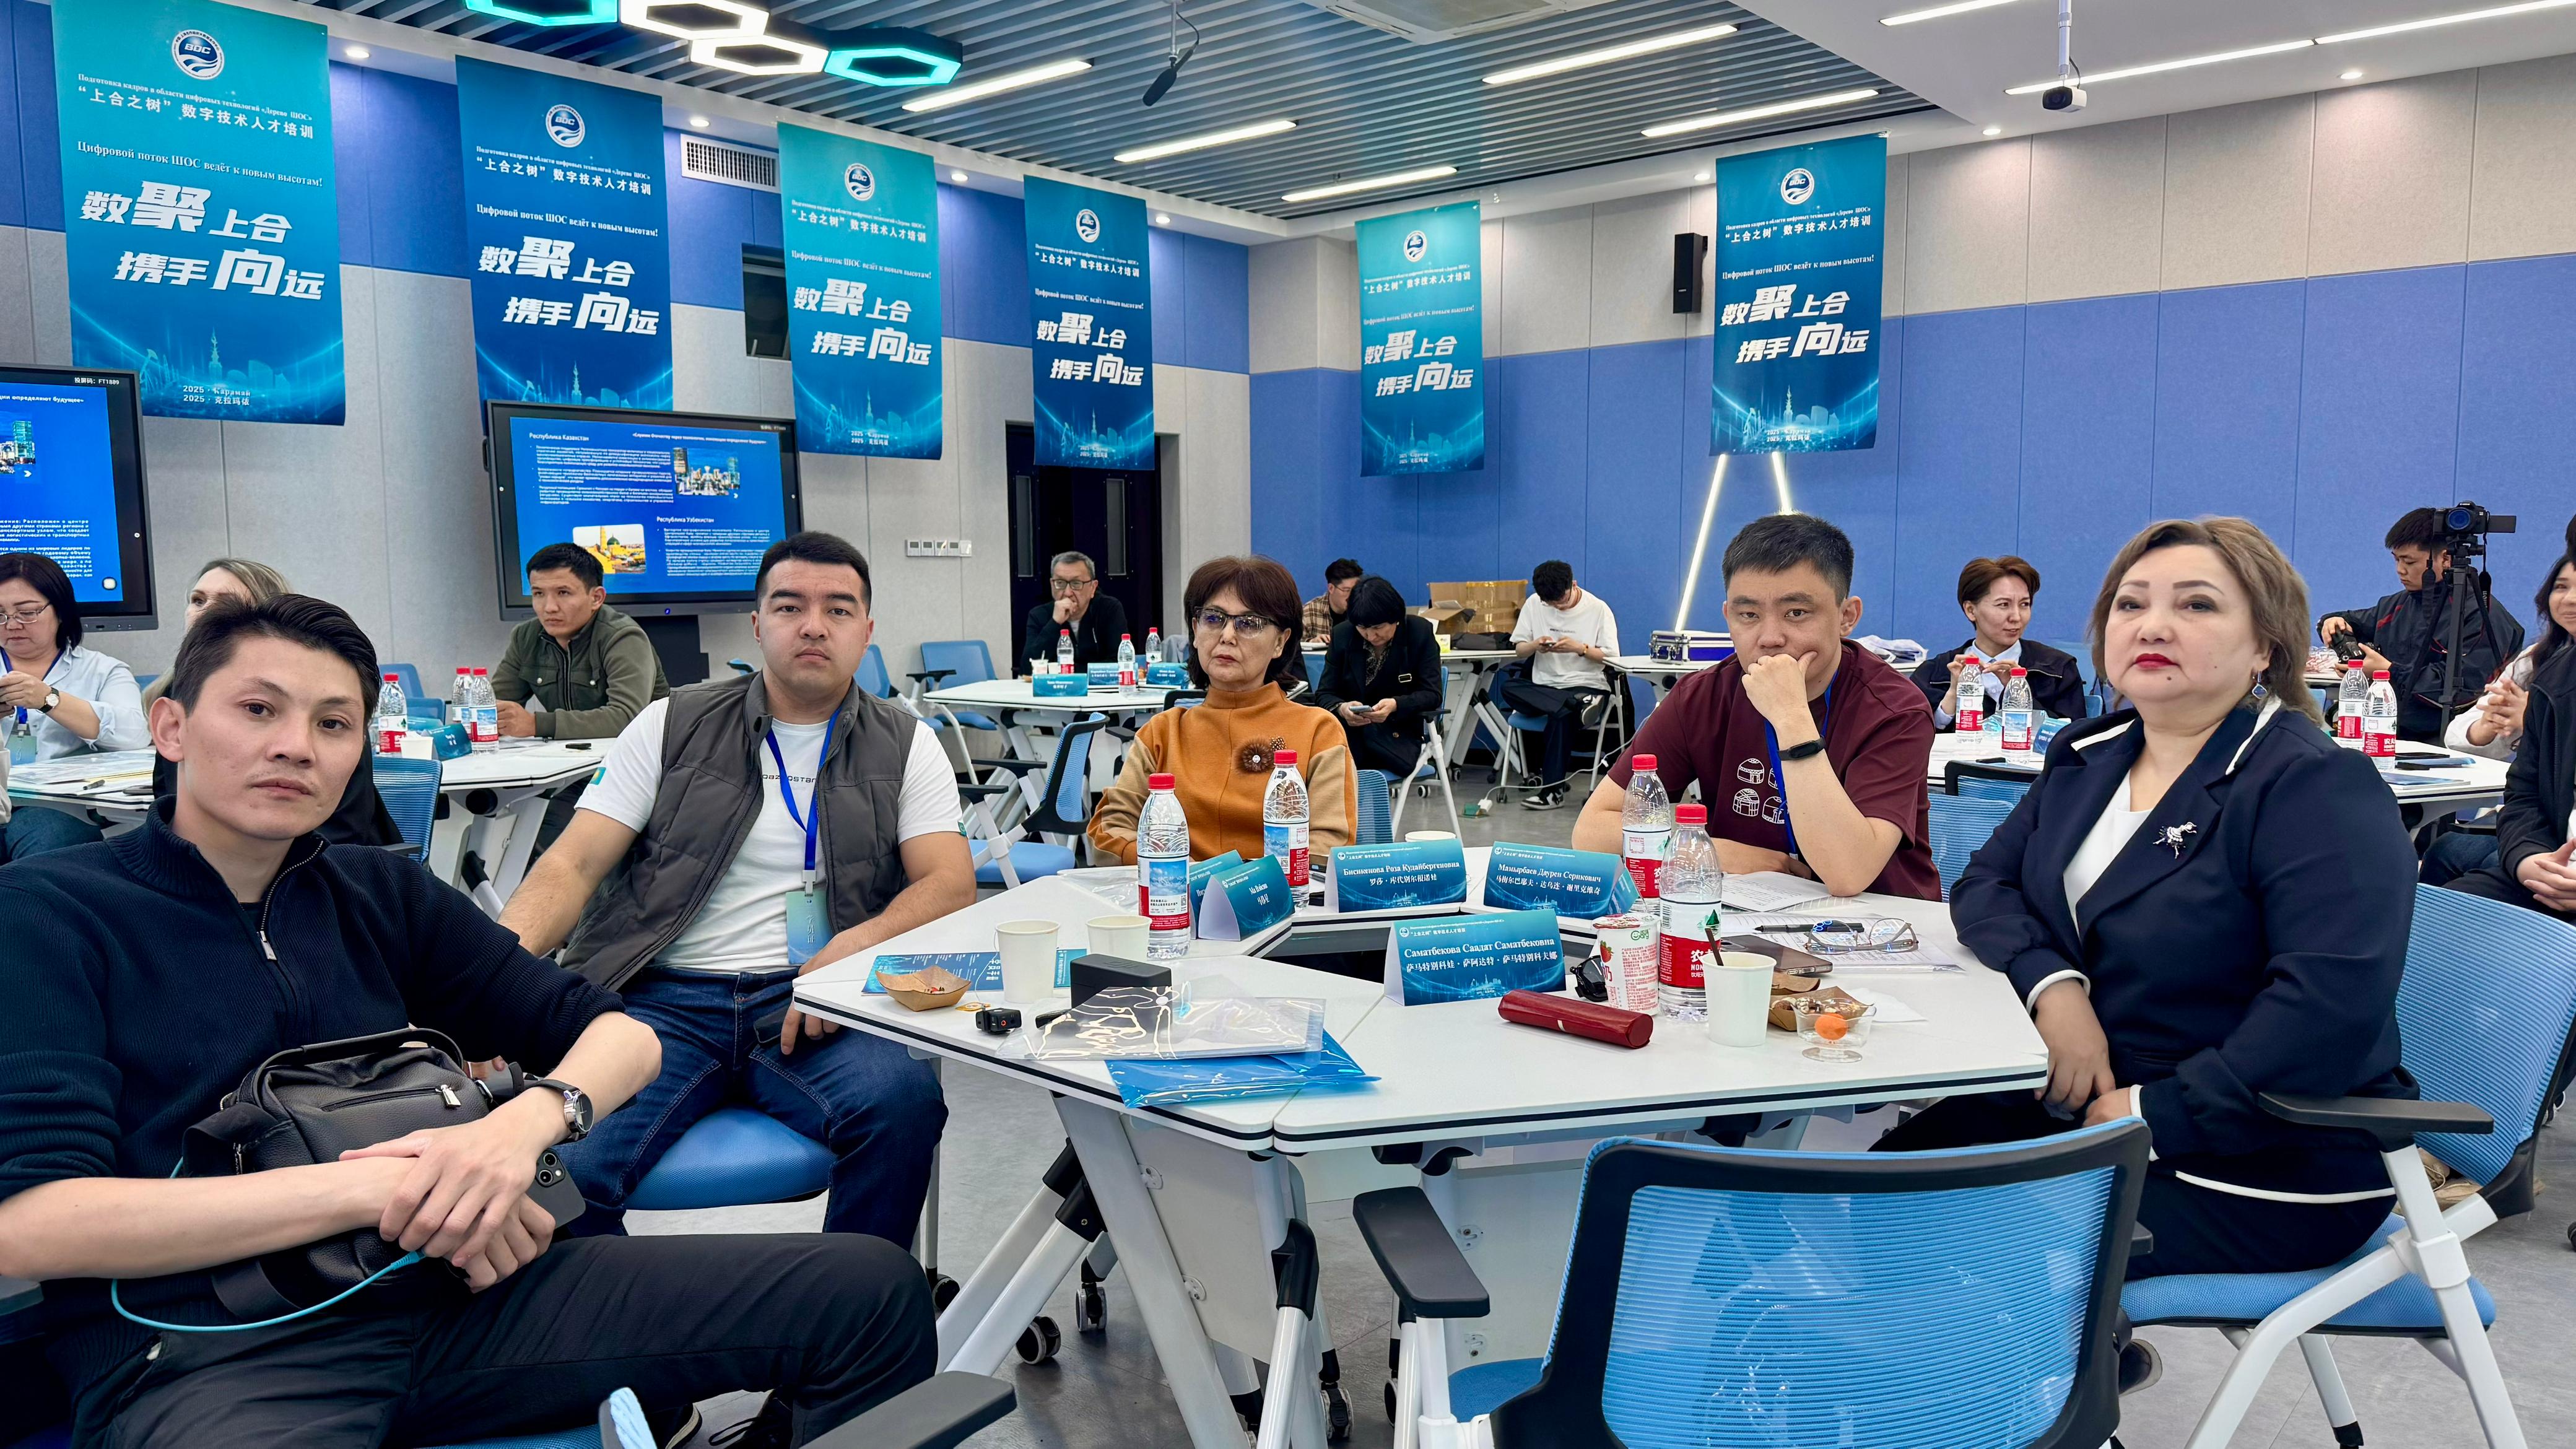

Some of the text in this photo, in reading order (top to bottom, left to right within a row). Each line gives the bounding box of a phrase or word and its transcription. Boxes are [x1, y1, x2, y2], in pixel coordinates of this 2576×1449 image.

[78, 74, 121, 87] Подготовка
[123, 83, 149, 92] кадров
[155, 88, 184, 98] области
[185, 94, 220, 105] цифровых
[222, 101, 259, 111] технологий
[261, 107, 287, 116] «Дерево
[290, 111, 311, 120] ШОС»
[79, 85, 313, 139] “上合之树” 数字技术人才培训
[78, 141, 134, 158] Цифровой
[138, 152, 168, 163] поток
[172, 155, 200, 168] ШОС
[204, 162, 230, 172] ведёт
[242, 168, 274, 180] новым
[278, 174, 322, 186] высотам!
[477, 157, 651, 195] “上合之树” 数字技术人才培训
[79, 180, 292, 243] 数聚上合
[477, 204, 518, 217] Цифровой
[520, 212, 543, 220] поток
[546, 213, 567, 224] ШОС
[569, 219, 589, 227] ведёт
[598, 222, 622, 232] новым
[624, 227, 658, 237] высотам!
[1725, 215, 1870, 243] “上合之树” 数字技术人才培训
[850, 219, 926, 243] 数字技术人才培训
[113, 248, 324, 300] 携手向远
[477, 236, 635, 287] 数聚上合
[1722, 270, 1754, 280] Цифровой
[1773, 263, 1792, 272] ШОС
[1793, 261, 1811, 269] ведёт
[1843, 255, 1874, 264] высотам!
[502, 291, 659, 335] 携手向远
[794, 278, 912, 323] 数聚上合
[1720, 284, 1850, 326] 数聚上合
[811, 326, 931, 365] 携手向远
[1036, 311, 1126, 349] 数聚上合
[1364, 329, 1457, 366] 数聚上合
[1735, 321, 1869, 363] 携手向远
[1050, 353, 1144, 386] 携手向远
[1375, 361, 1474, 396] 携手向远
[183, 385, 250, 397] 2025 Карамай
[184, 394, 250, 406] 2025 克拉玛依
[529, 432, 561, 441] Республика
[1386, 864, 1401, 873] Роза
[1537, 868, 1562, 878] Даурен
[1563, 870, 1601, 883] Серикович
[1404, 938, 1555, 958] Саматбекова Саадат Саматбековна
